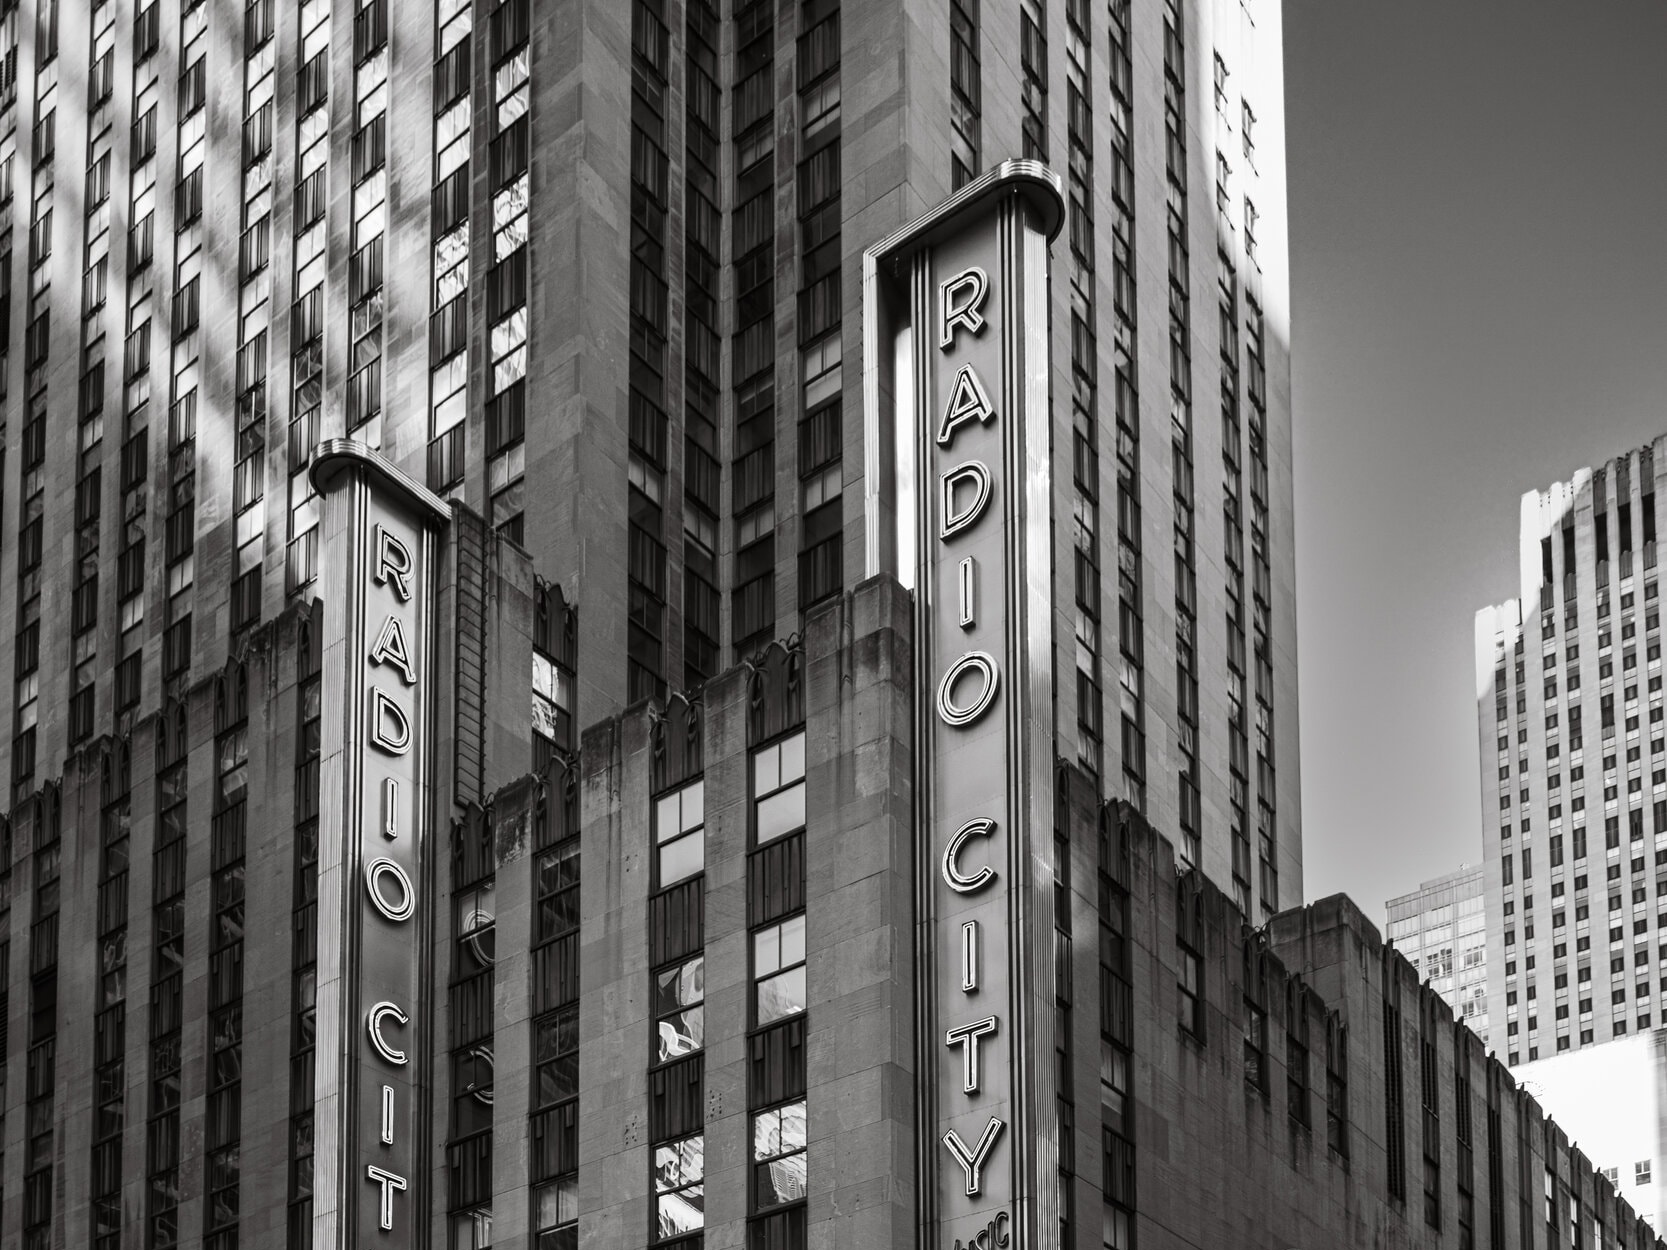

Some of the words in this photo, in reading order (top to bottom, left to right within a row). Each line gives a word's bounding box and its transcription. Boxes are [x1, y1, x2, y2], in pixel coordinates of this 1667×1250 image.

[937, 266, 1000, 726] RADIO
[366, 522, 417, 922] RADIO
[942, 817, 1005, 1196] CITY
